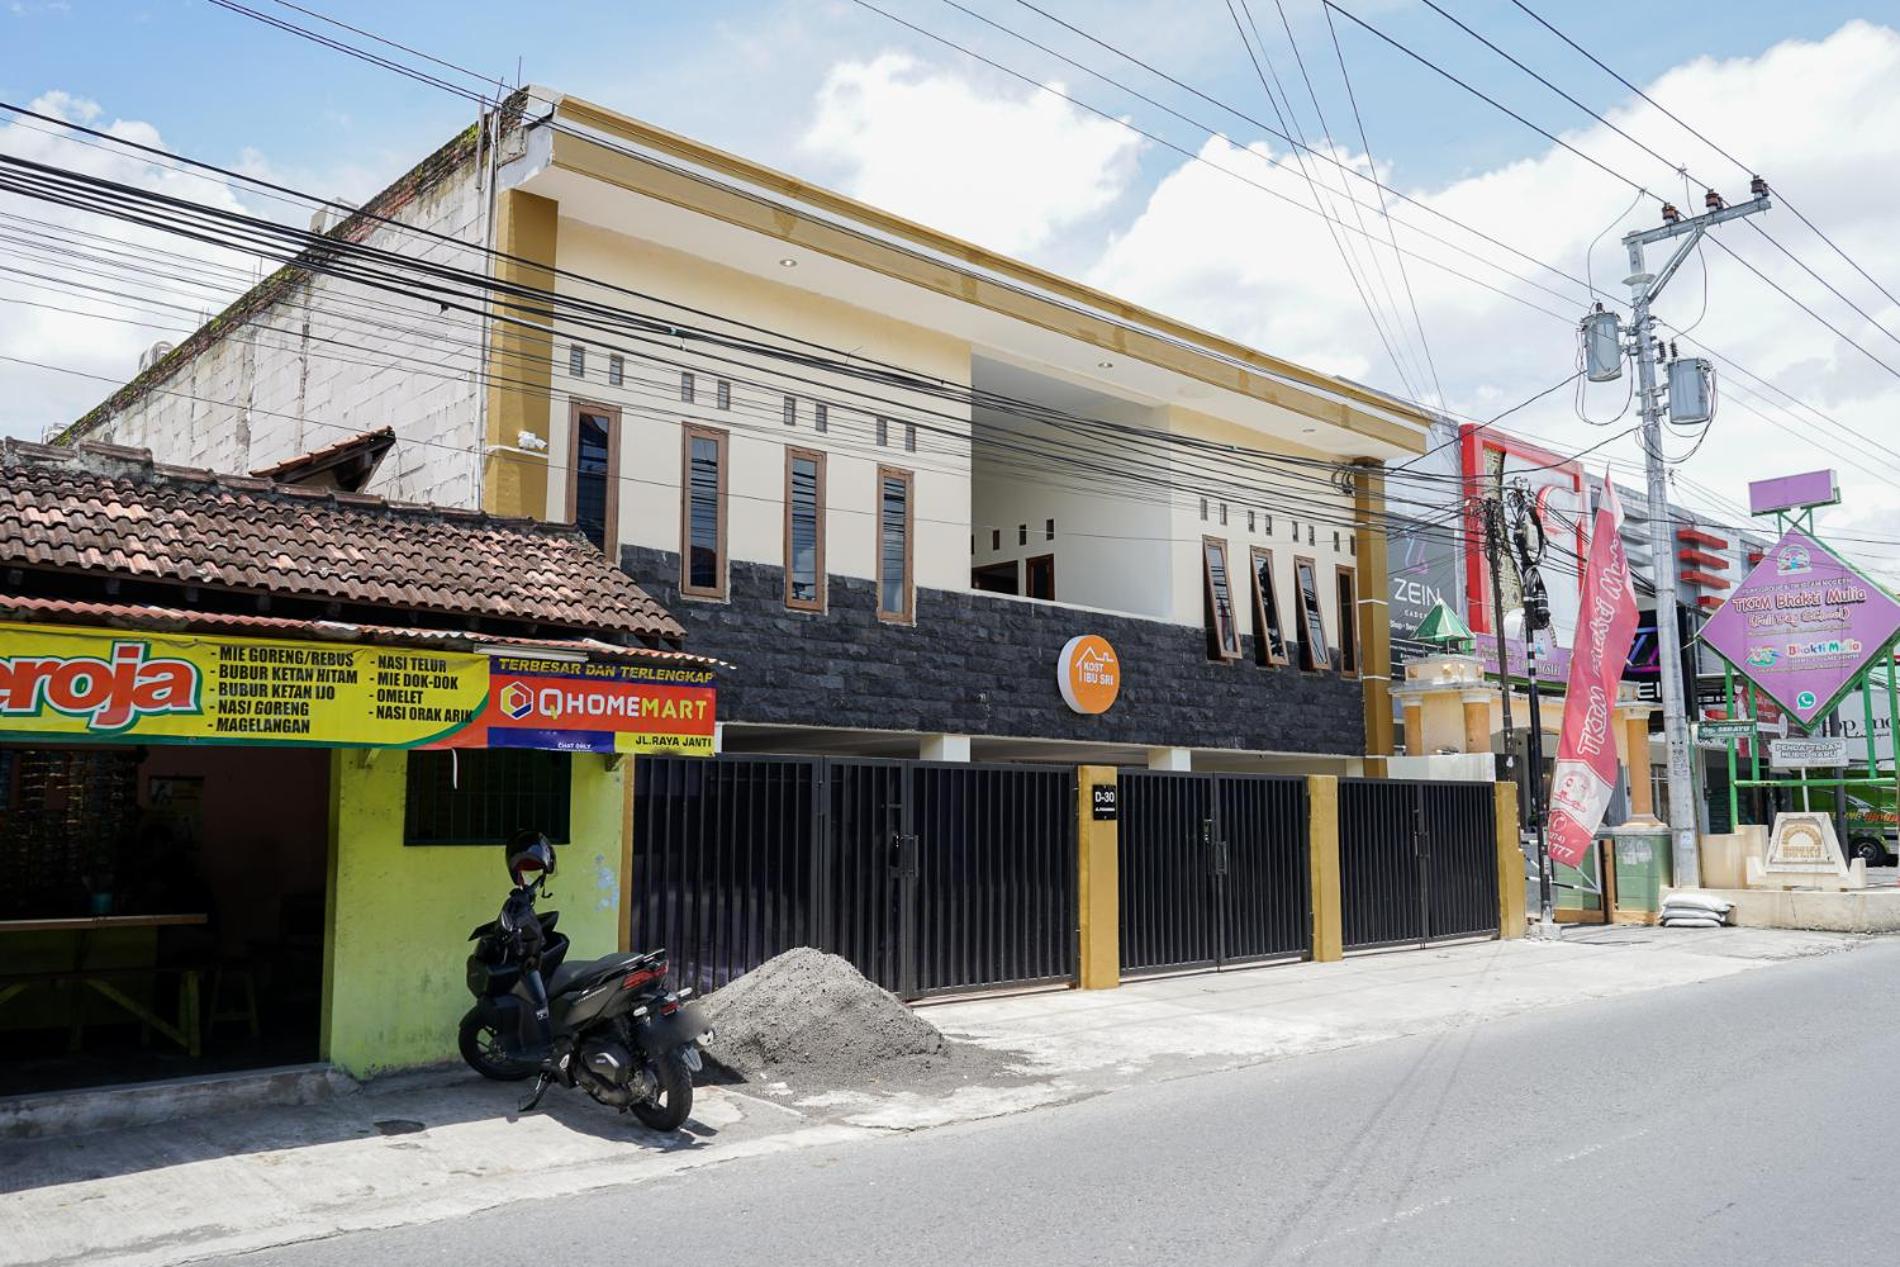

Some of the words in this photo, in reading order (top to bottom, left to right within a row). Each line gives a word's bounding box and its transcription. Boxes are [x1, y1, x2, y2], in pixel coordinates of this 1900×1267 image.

[1393, 577, 1440, 607] ZEIN
[1776, 592, 1822, 610] Bhakti
[1826, 587, 1867, 605] Mulia
[220, 646, 245, 661] MIE
[250, 648, 354, 666] GORENG/REBUS
[378, 655, 407, 670] NASI
[410, 657, 447, 673] TELUR
[219, 664, 268, 680] BUBUR
[272, 667, 313, 682] KETAN
[317, 669, 358, 684] HITAM
[499, 658, 580, 675] TERBESAR
[585, 664, 615, 676] DAN
[620, 666, 713, 683] TERLENGKAP
[377, 672, 400, 686] MIE
[403, 674, 458, 690] DOK-DOK
[219, 682, 268, 697] BUBUR
[272, 685, 312, 699] KETAN
[316, 686, 335, 700] IJO
[377, 689, 423, 704] OMELET
[218, 700, 251, 714] NASI
[254, 701, 309, 716] GORENG
[376, 705, 406, 720] NASI
[409, 707, 442, 721] ORAK
[445, 709, 474, 723] ARIK
[216, 718, 310, 733] MAGELANGAN
[682, 737, 711, 748] JANTI
[1095, 791, 1115, 803] D-30
